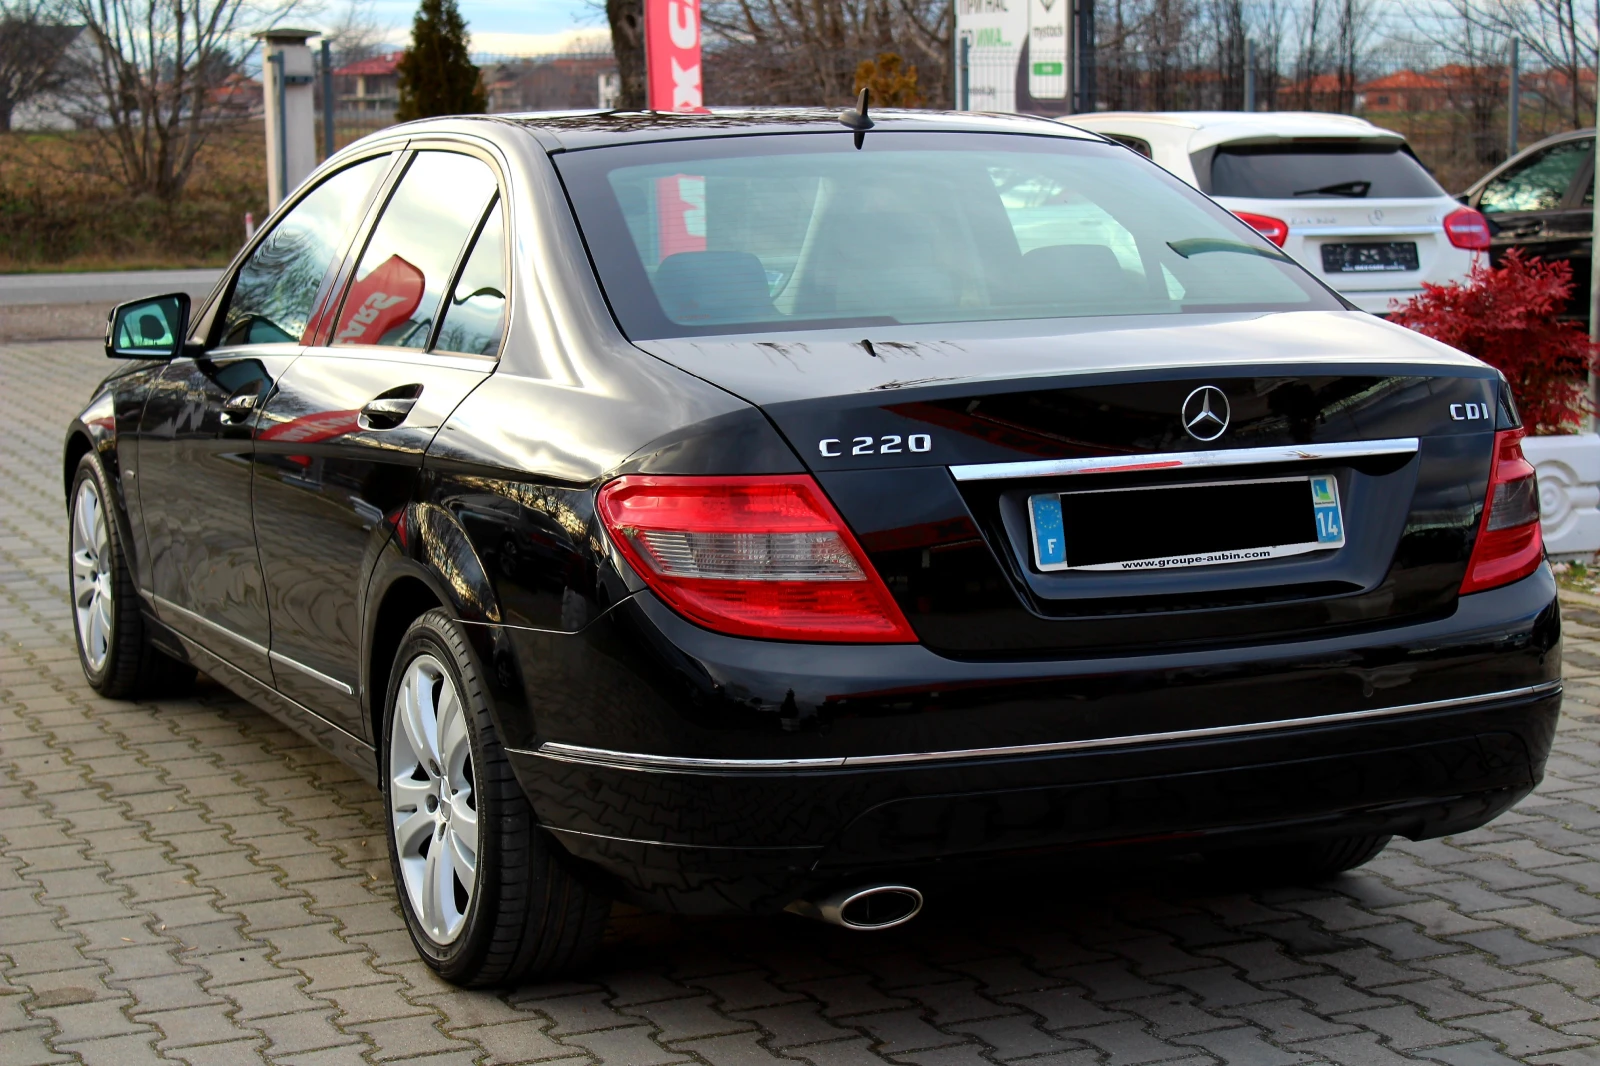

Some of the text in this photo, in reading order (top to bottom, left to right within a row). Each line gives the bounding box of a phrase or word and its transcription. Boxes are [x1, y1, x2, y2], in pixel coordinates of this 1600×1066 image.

[1449, 403, 1489, 421] CDI
[818, 433, 932, 458] C 220
[1317, 511, 1339, 537] 14
[1047, 538, 1057, 555] F
[1122, 549, 1271, 569] www.groupe-aubin.com
